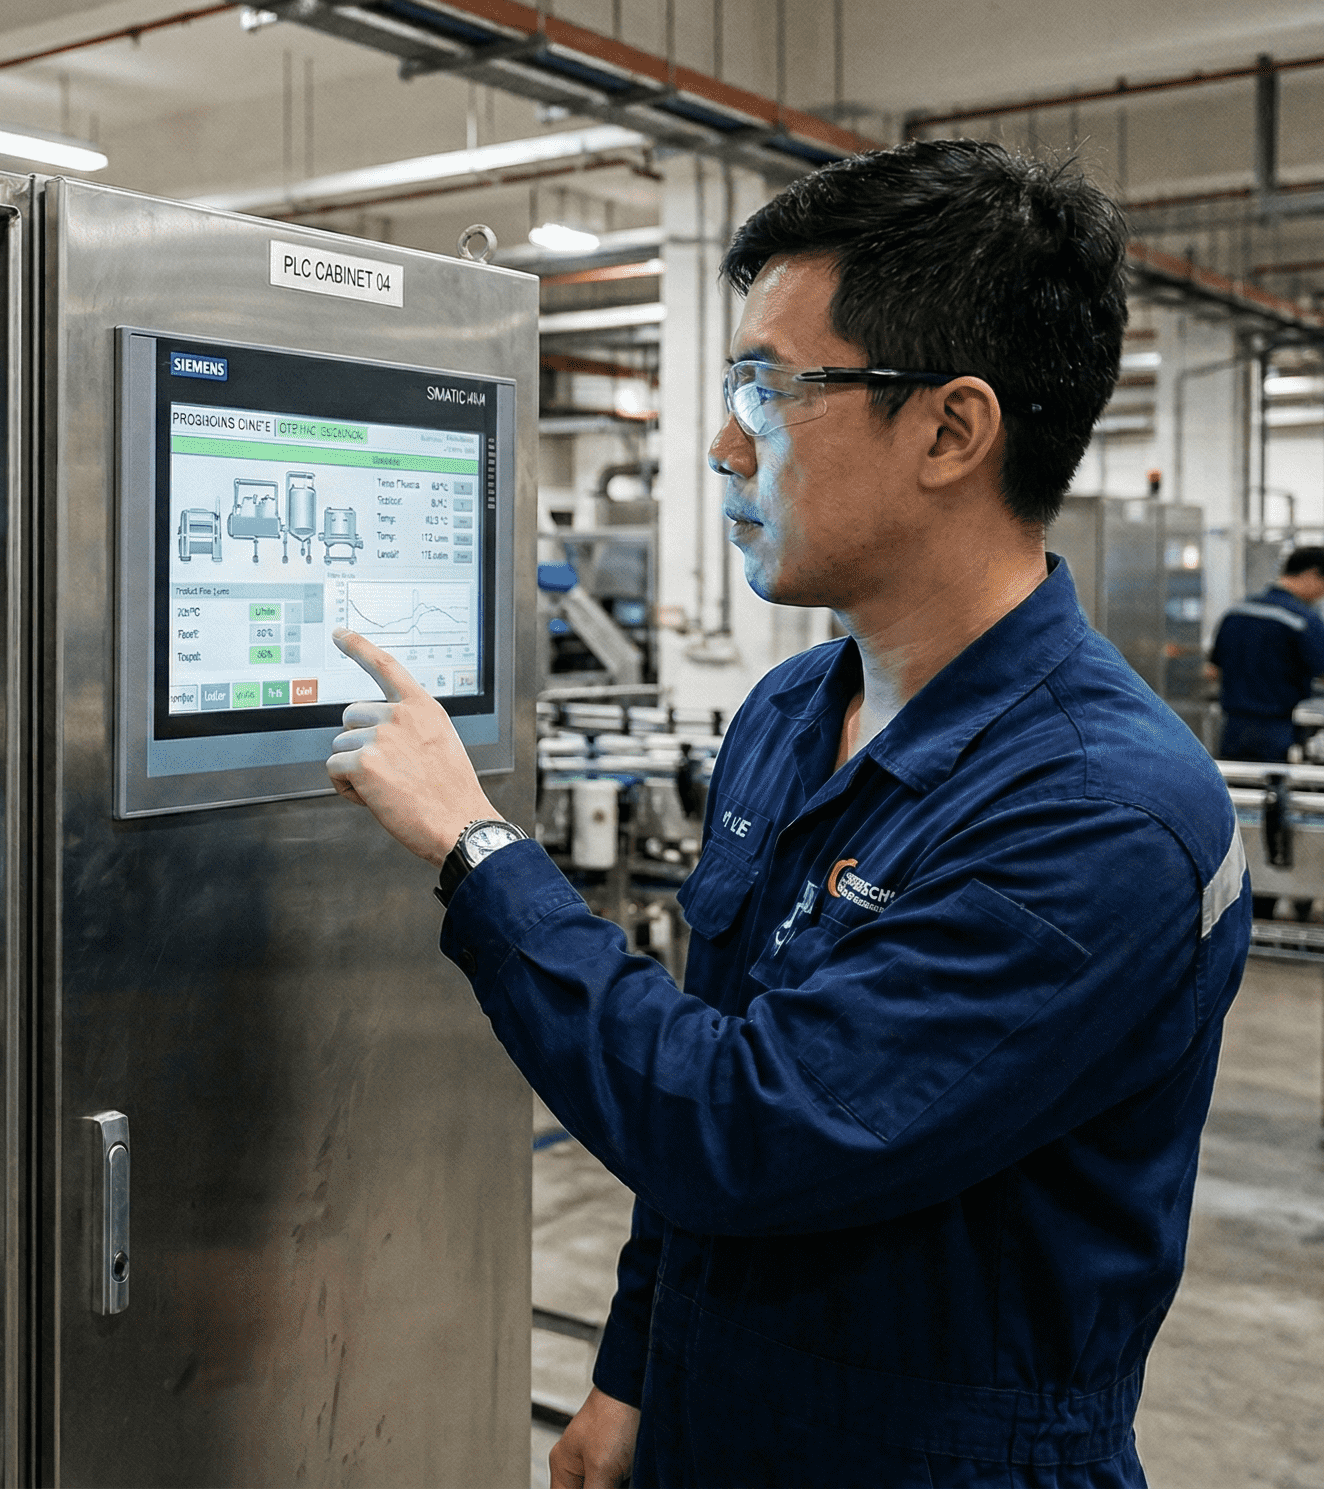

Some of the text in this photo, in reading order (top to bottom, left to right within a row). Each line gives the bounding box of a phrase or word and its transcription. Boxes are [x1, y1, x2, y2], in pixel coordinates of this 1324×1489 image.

[284, 255, 391, 292] PLC CABINET 04
[173, 357, 226, 378] SIEMENS
